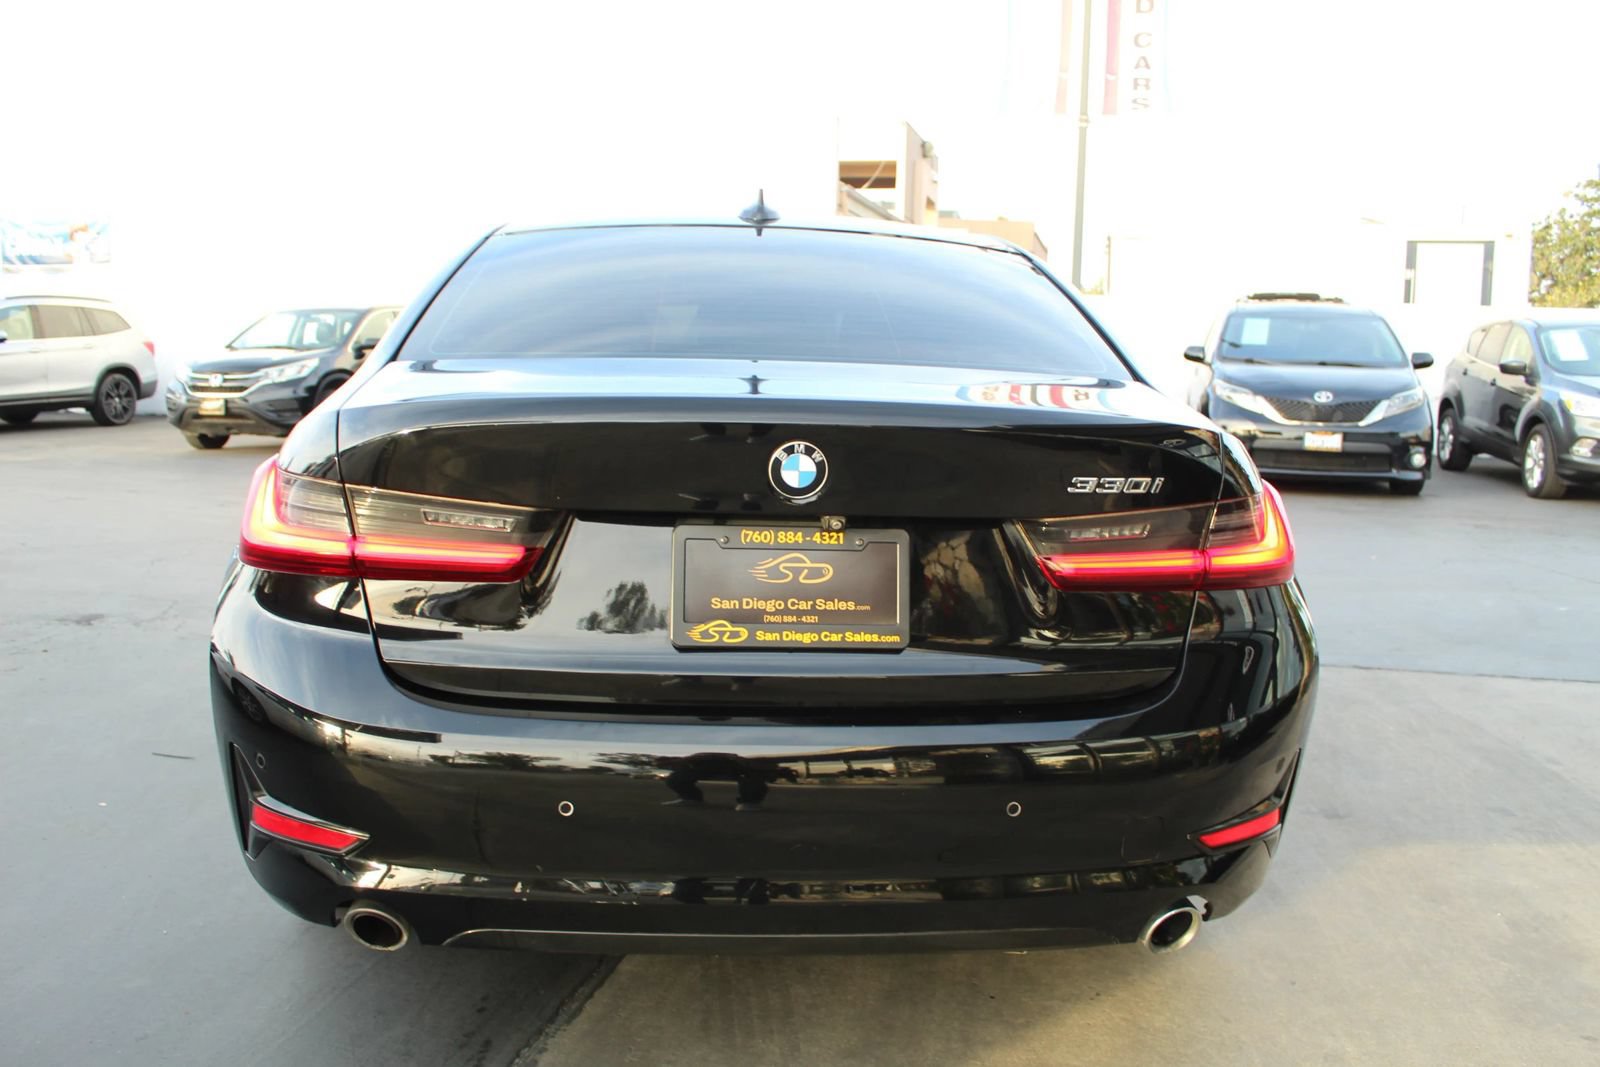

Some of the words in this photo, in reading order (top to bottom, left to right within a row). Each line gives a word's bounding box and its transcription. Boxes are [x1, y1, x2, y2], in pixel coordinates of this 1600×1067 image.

[1132, 32, 1153, 110] CARS
[775, 443, 825, 463] BMW
[1067, 477, 1165, 494] 330i
[741, 529, 775, 545] (760)
[777, 531, 803, 544] 884
[812, 532, 845, 545] 4321
[711, 597, 739, 609] San
[742, 597, 785, 612] Diego
[787, 598, 813, 610] Car
[763, 614, 782, 624] (760)
[783, 615, 797, 623] 884
[801, 615, 818, 624] 4321
[755, 630, 780, 641] San
[782, 630, 819, 644] Diego
[820, 631, 843, 642] Car
[844, 631, 900, 643] Sales.com
